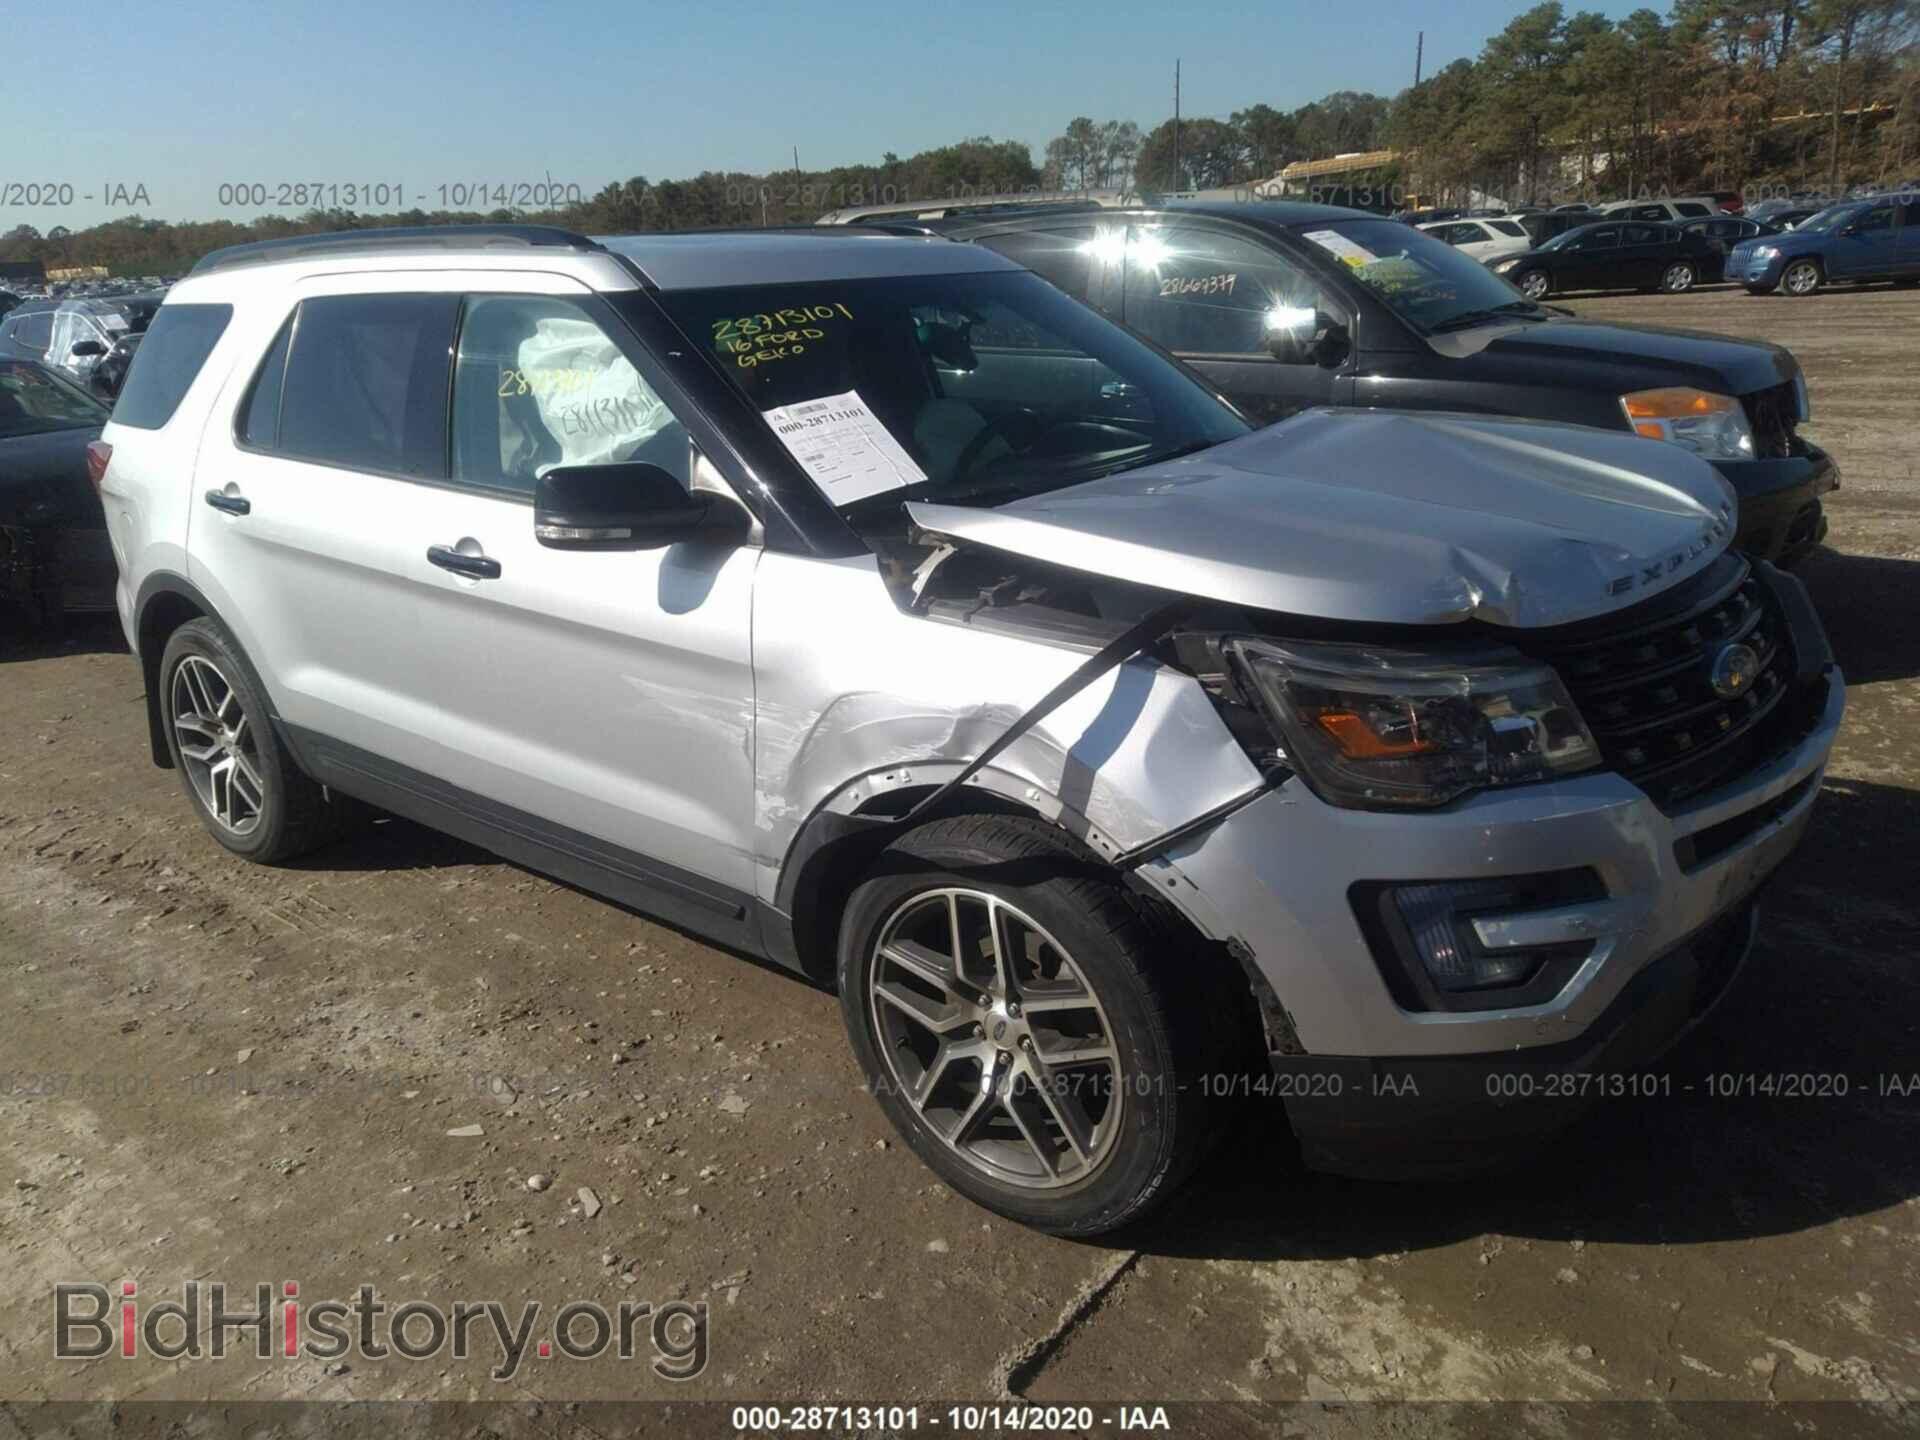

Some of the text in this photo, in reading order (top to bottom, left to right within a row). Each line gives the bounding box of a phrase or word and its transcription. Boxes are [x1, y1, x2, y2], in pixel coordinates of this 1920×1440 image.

[711, 302, 854, 340] 28713101
[727, 328, 825, 354] 16 FORD
[778, 407, 865, 434] 000-28713101
